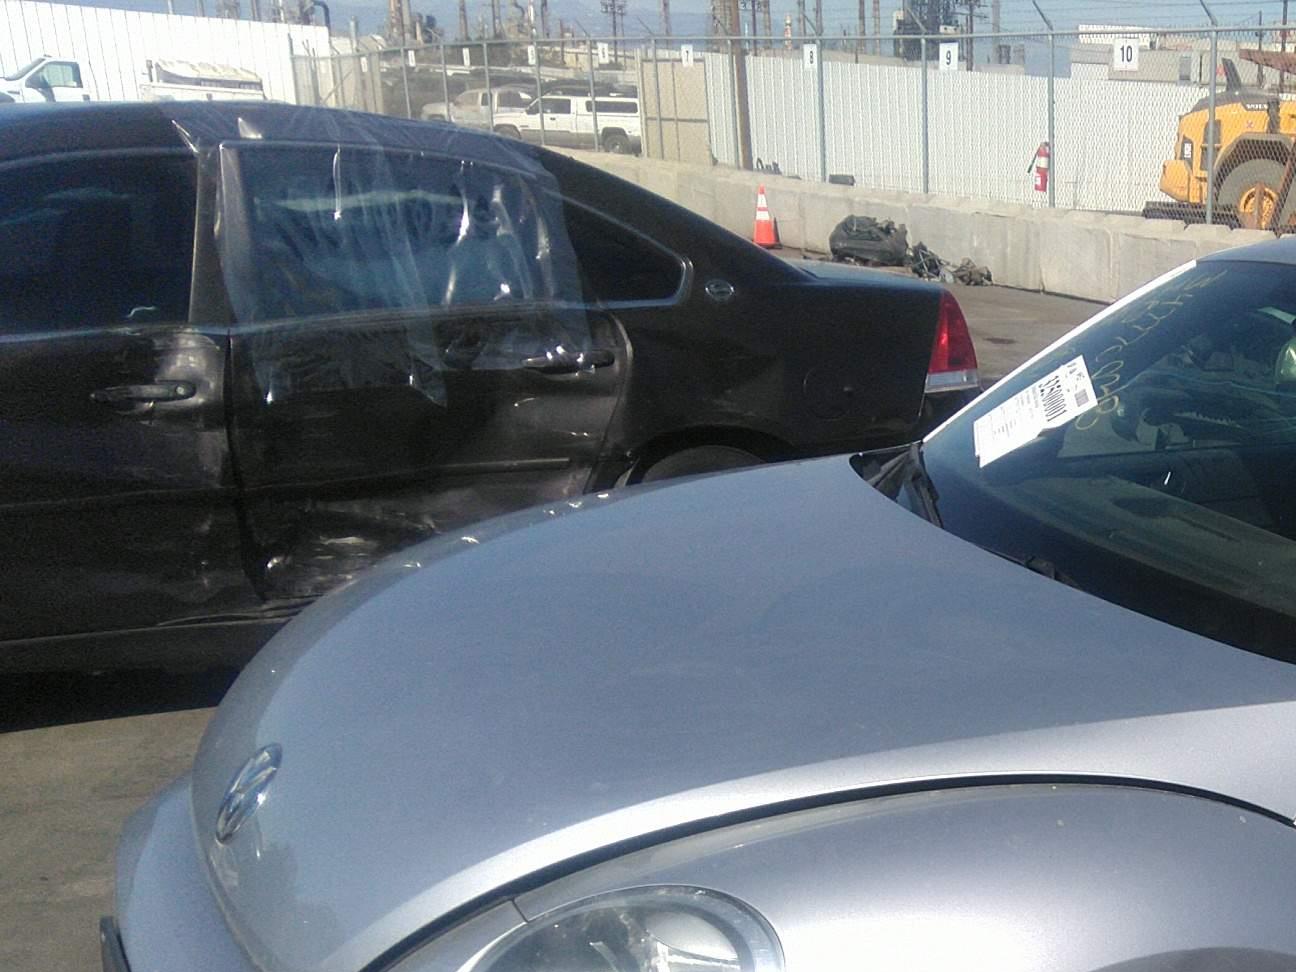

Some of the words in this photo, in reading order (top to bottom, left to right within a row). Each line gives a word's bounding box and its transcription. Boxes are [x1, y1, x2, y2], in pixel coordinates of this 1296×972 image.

[809, 50, 814, 64] 8
[945, 50, 951, 65] 9
[1120, 46, 1132, 62] 10
[1038, 375, 1068, 422] 32500001
